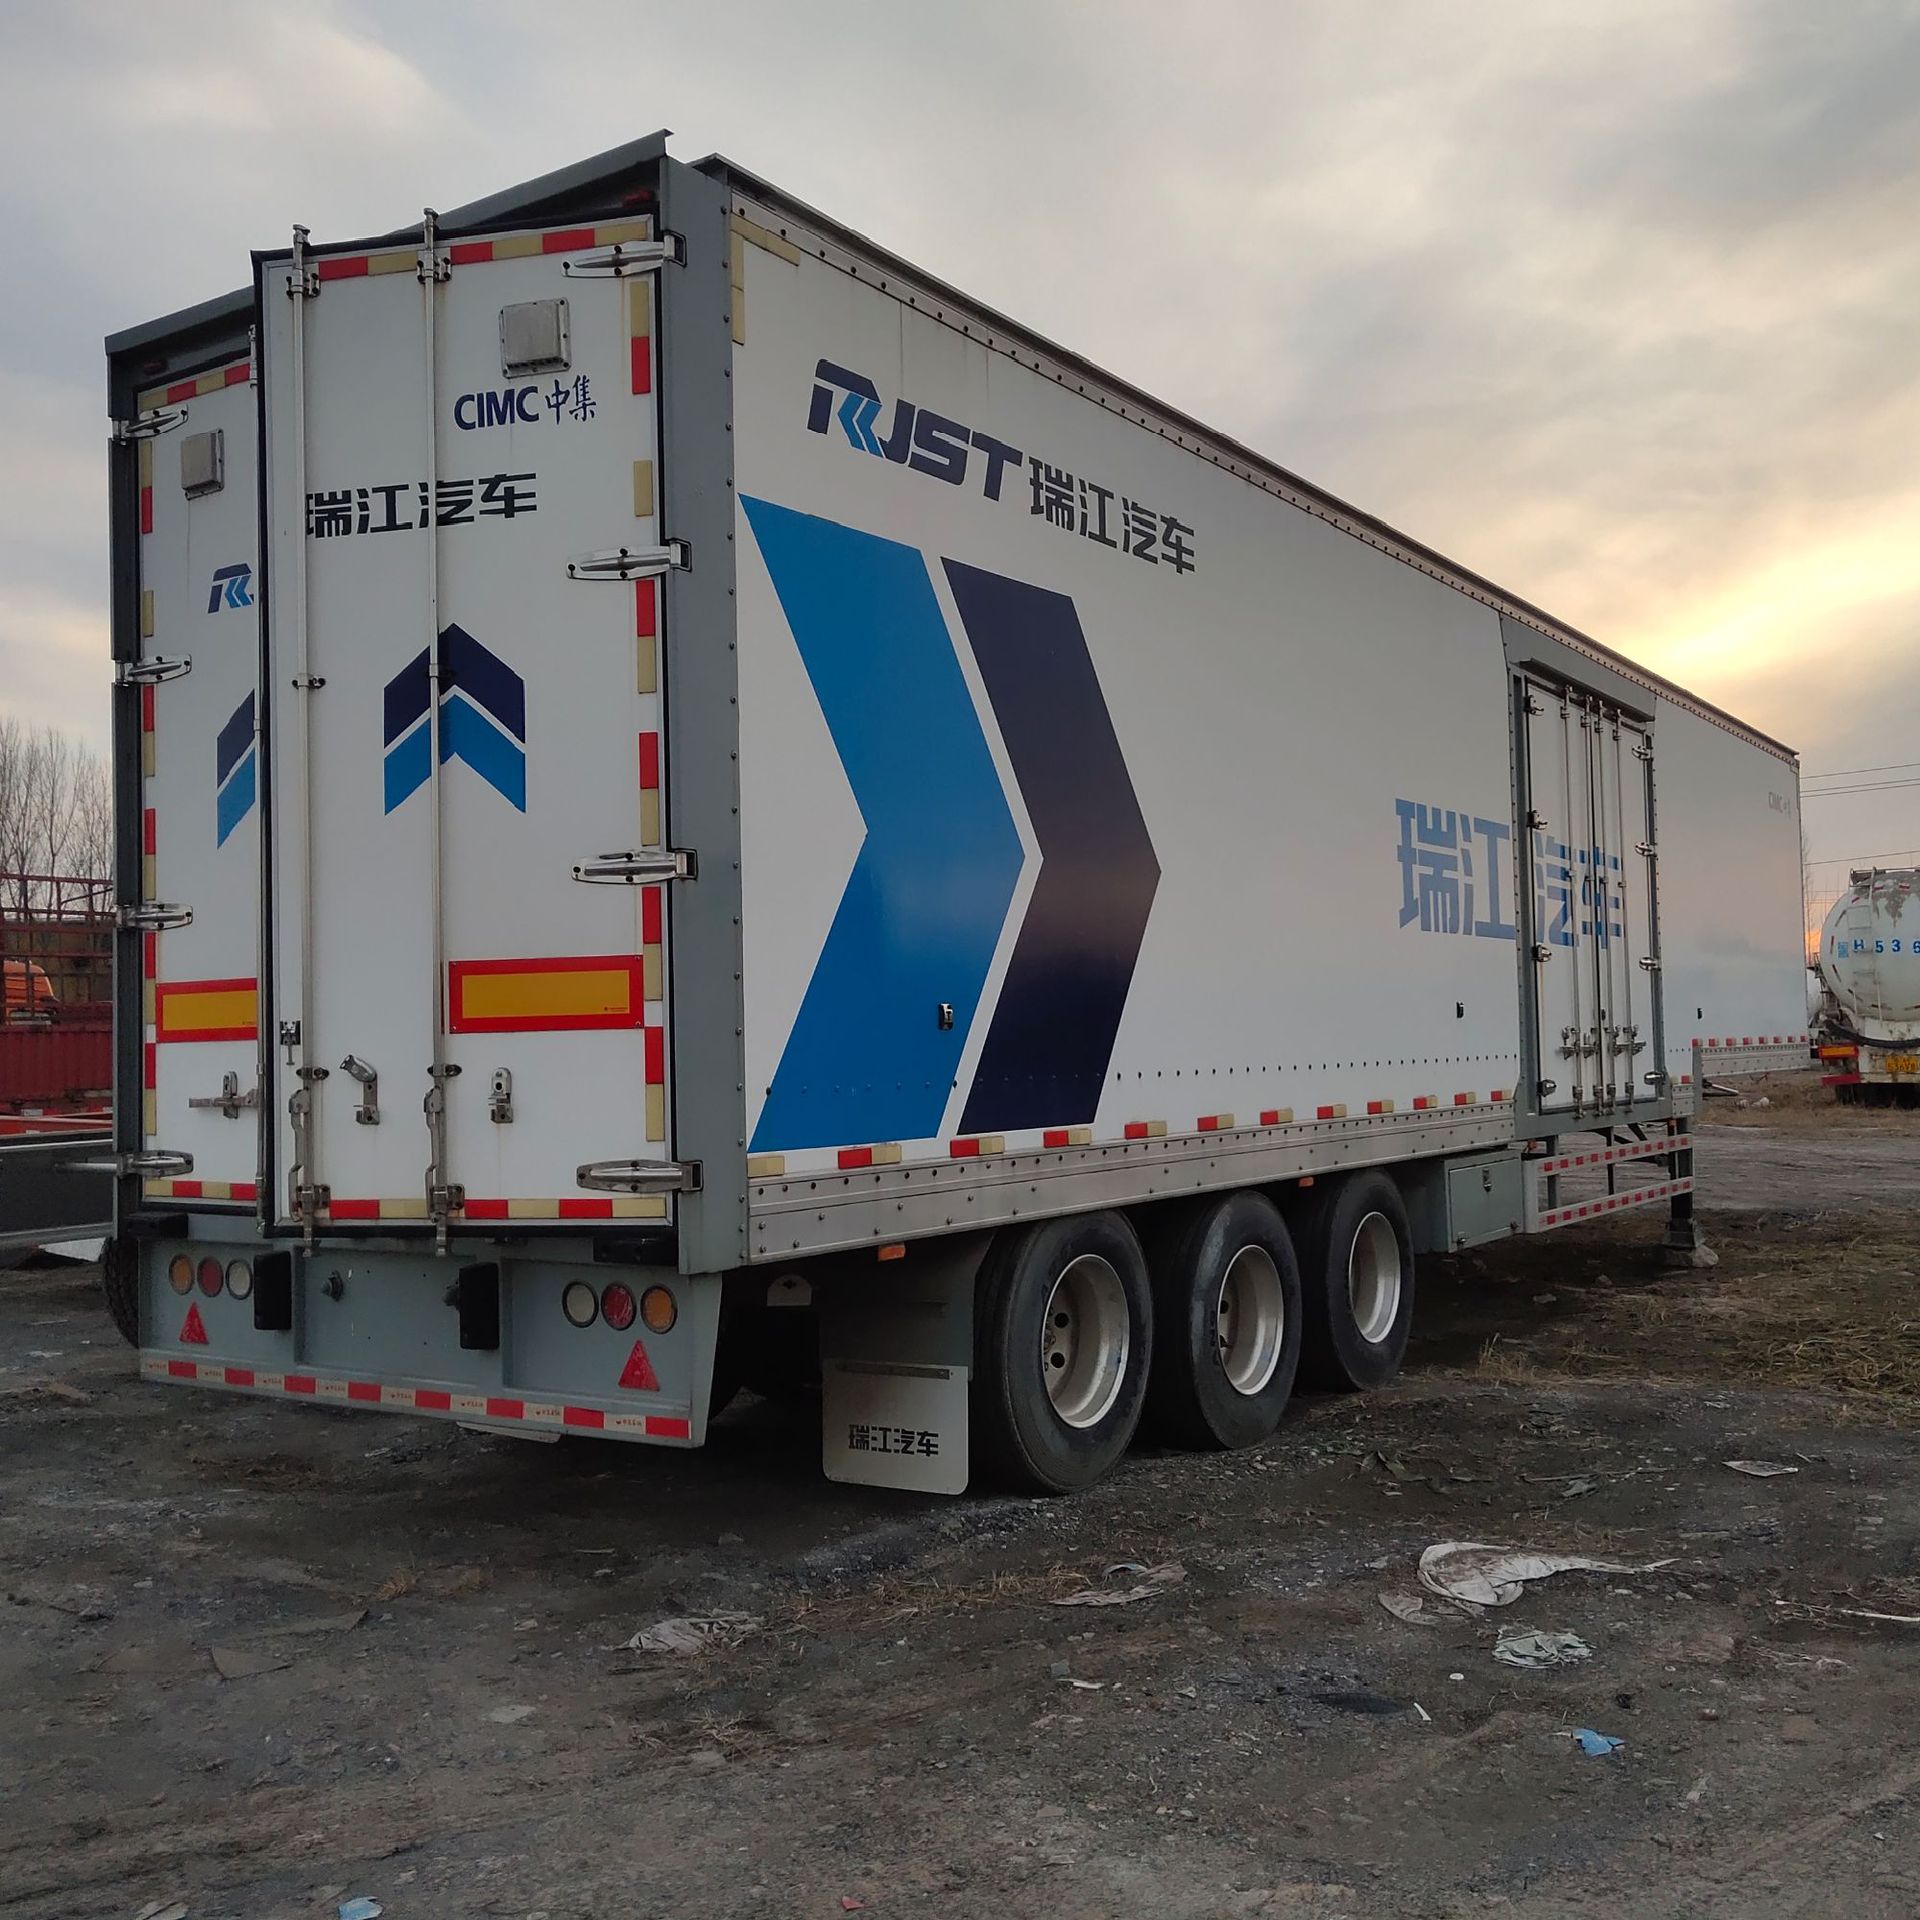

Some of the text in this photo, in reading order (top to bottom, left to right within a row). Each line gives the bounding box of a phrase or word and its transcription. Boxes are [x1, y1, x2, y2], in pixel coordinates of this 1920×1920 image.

[454, 374, 597, 430] CIMC 中集
[807, 358, 1196, 574] RJST 瑞江汽车
[305, 472, 537, 538] 瑞江汽车
[1395, 798, 1622, 950] 瑞江汽车
[848, 1423, 939, 1457] 瑞江汽车
